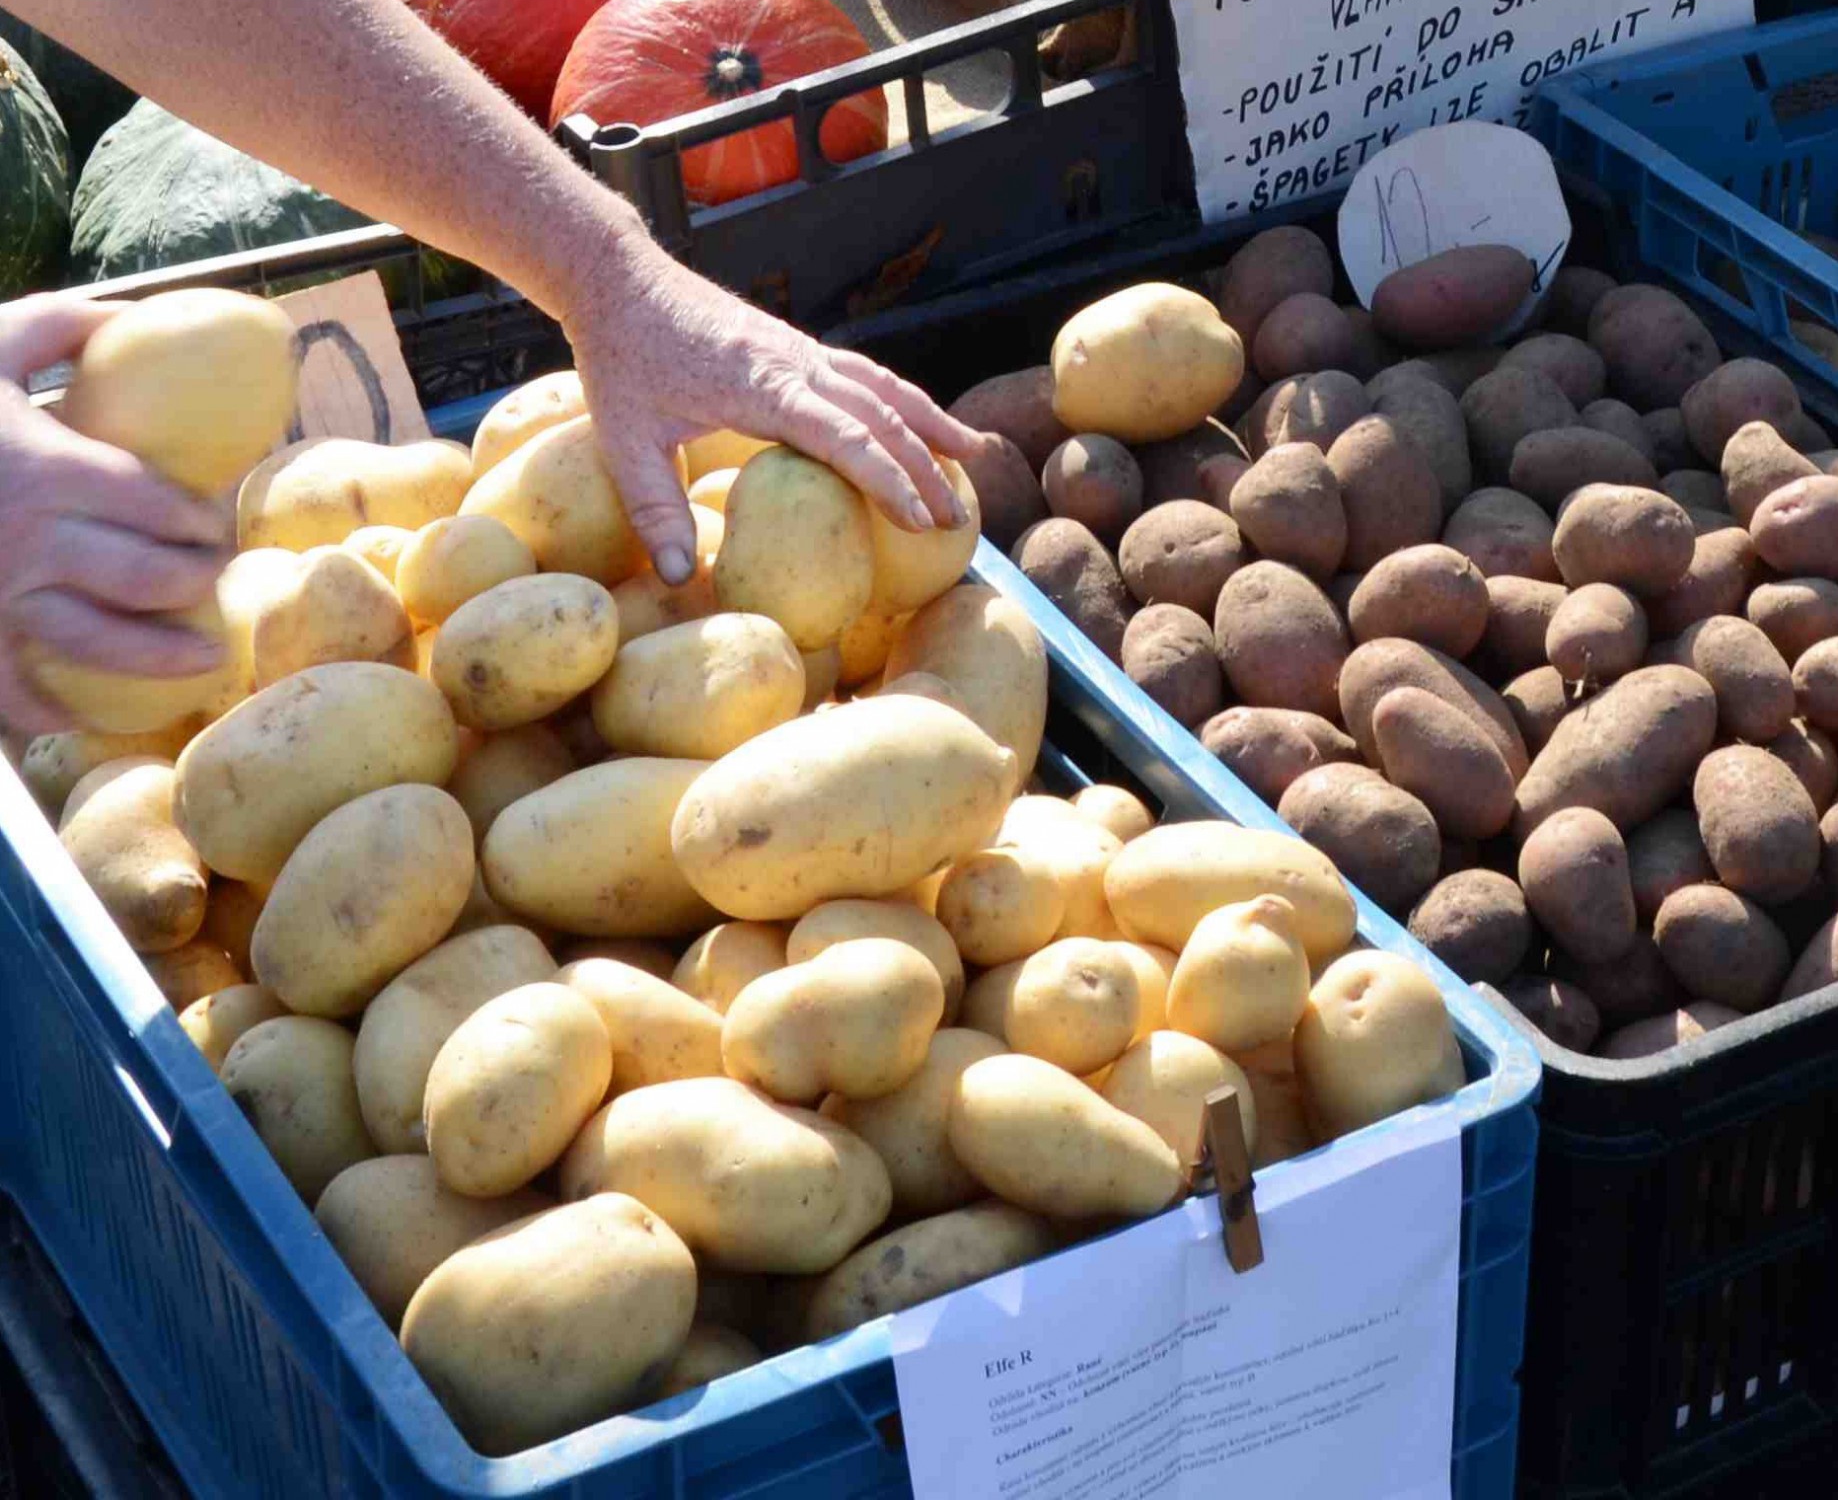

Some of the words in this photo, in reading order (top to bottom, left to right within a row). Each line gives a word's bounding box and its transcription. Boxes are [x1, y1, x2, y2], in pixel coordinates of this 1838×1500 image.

[1417, 5, 1462, 55] DO
[1362, 29, 1515, 118] PŘÍLOHA
[983, 1358, 1017, 1380] Elfe
[1019, 1349, 1034, 1367] R
